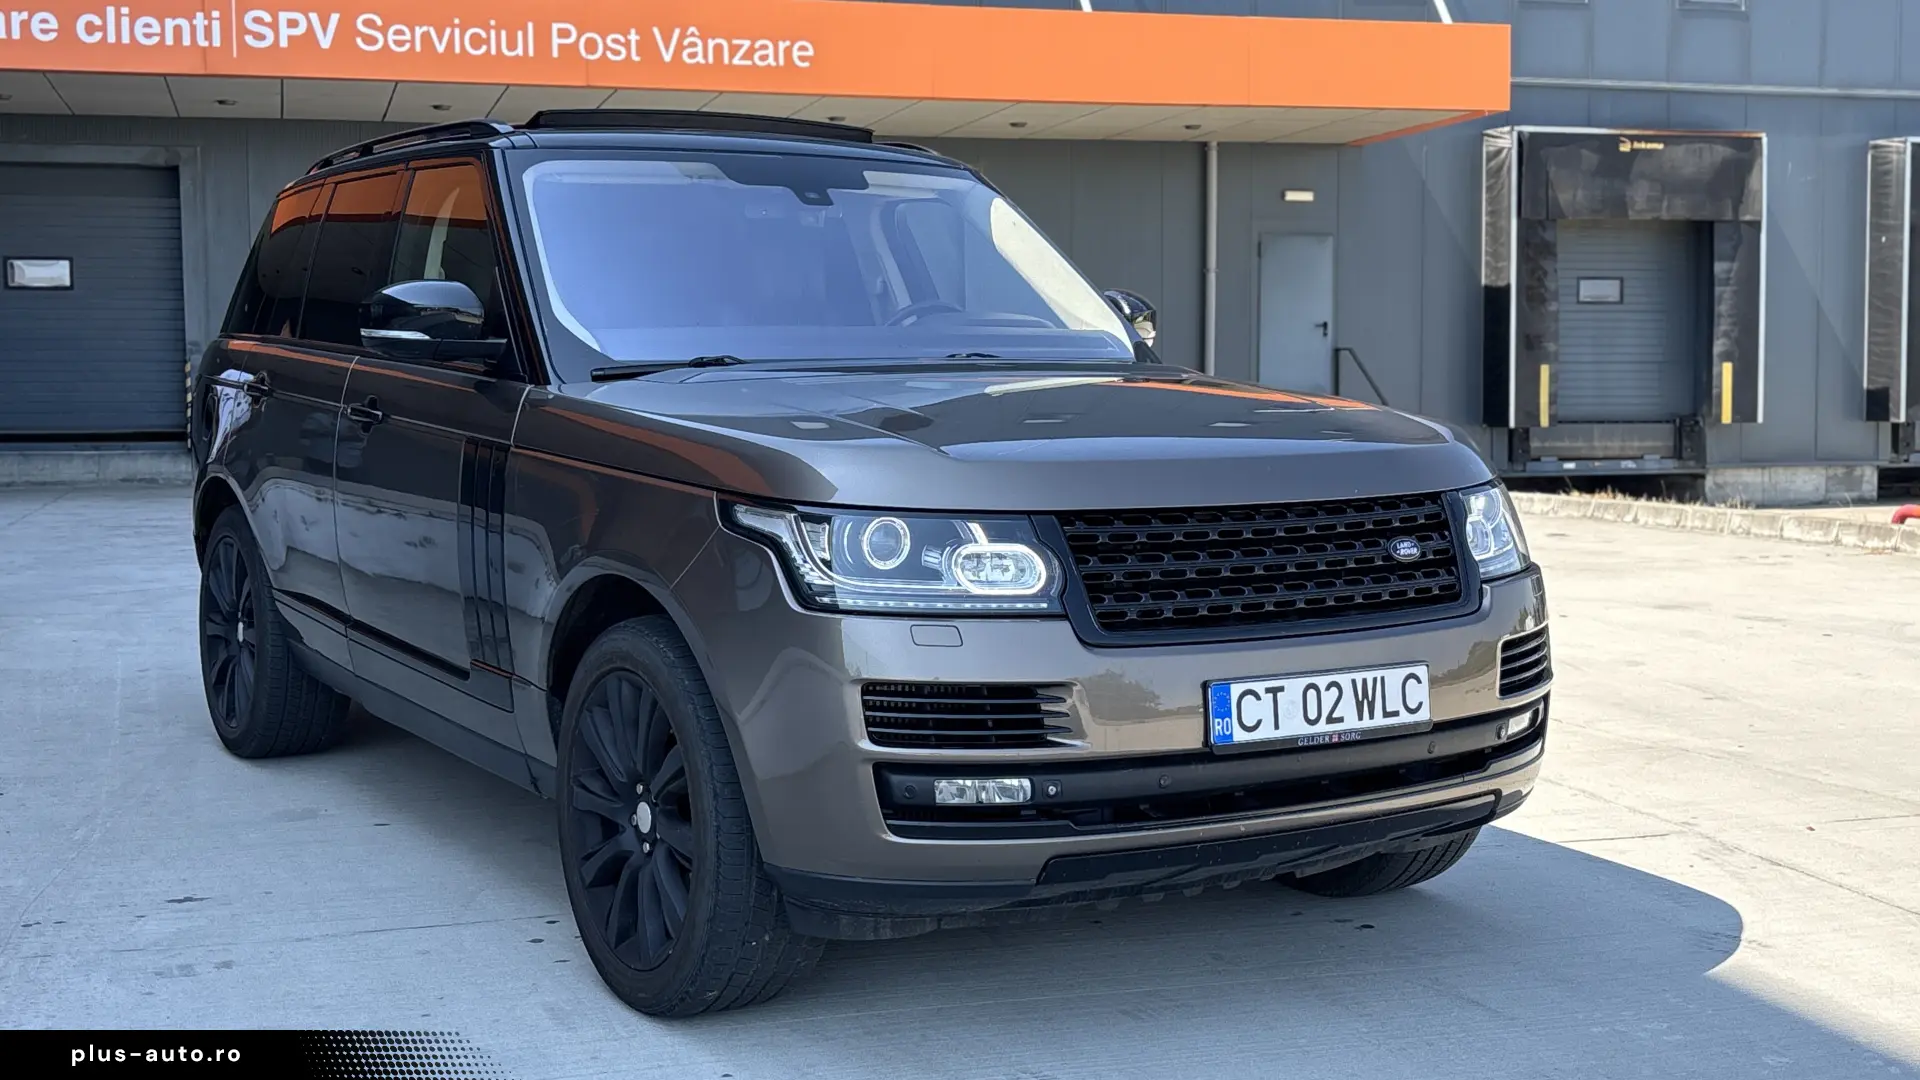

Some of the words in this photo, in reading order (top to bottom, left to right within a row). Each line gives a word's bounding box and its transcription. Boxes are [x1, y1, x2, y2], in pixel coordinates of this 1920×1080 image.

[0, 9, 59, 43] re
[75, 5, 222, 48] clienti
[242, 9, 341, 50] SPV
[354, 13, 535, 57] Serviciul
[550, 22, 641, 62] Post
[652, 26, 815, 68] Vânzare
[1235, 685, 1286, 733] CT
[1301, 680, 1345, 727] 02
[1350, 672, 1424, 722] WLC
[1214, 717, 1232, 736] RO
[1297, 735, 1330, 746] GELDER
[1340, 731, 1362, 741] SORG
